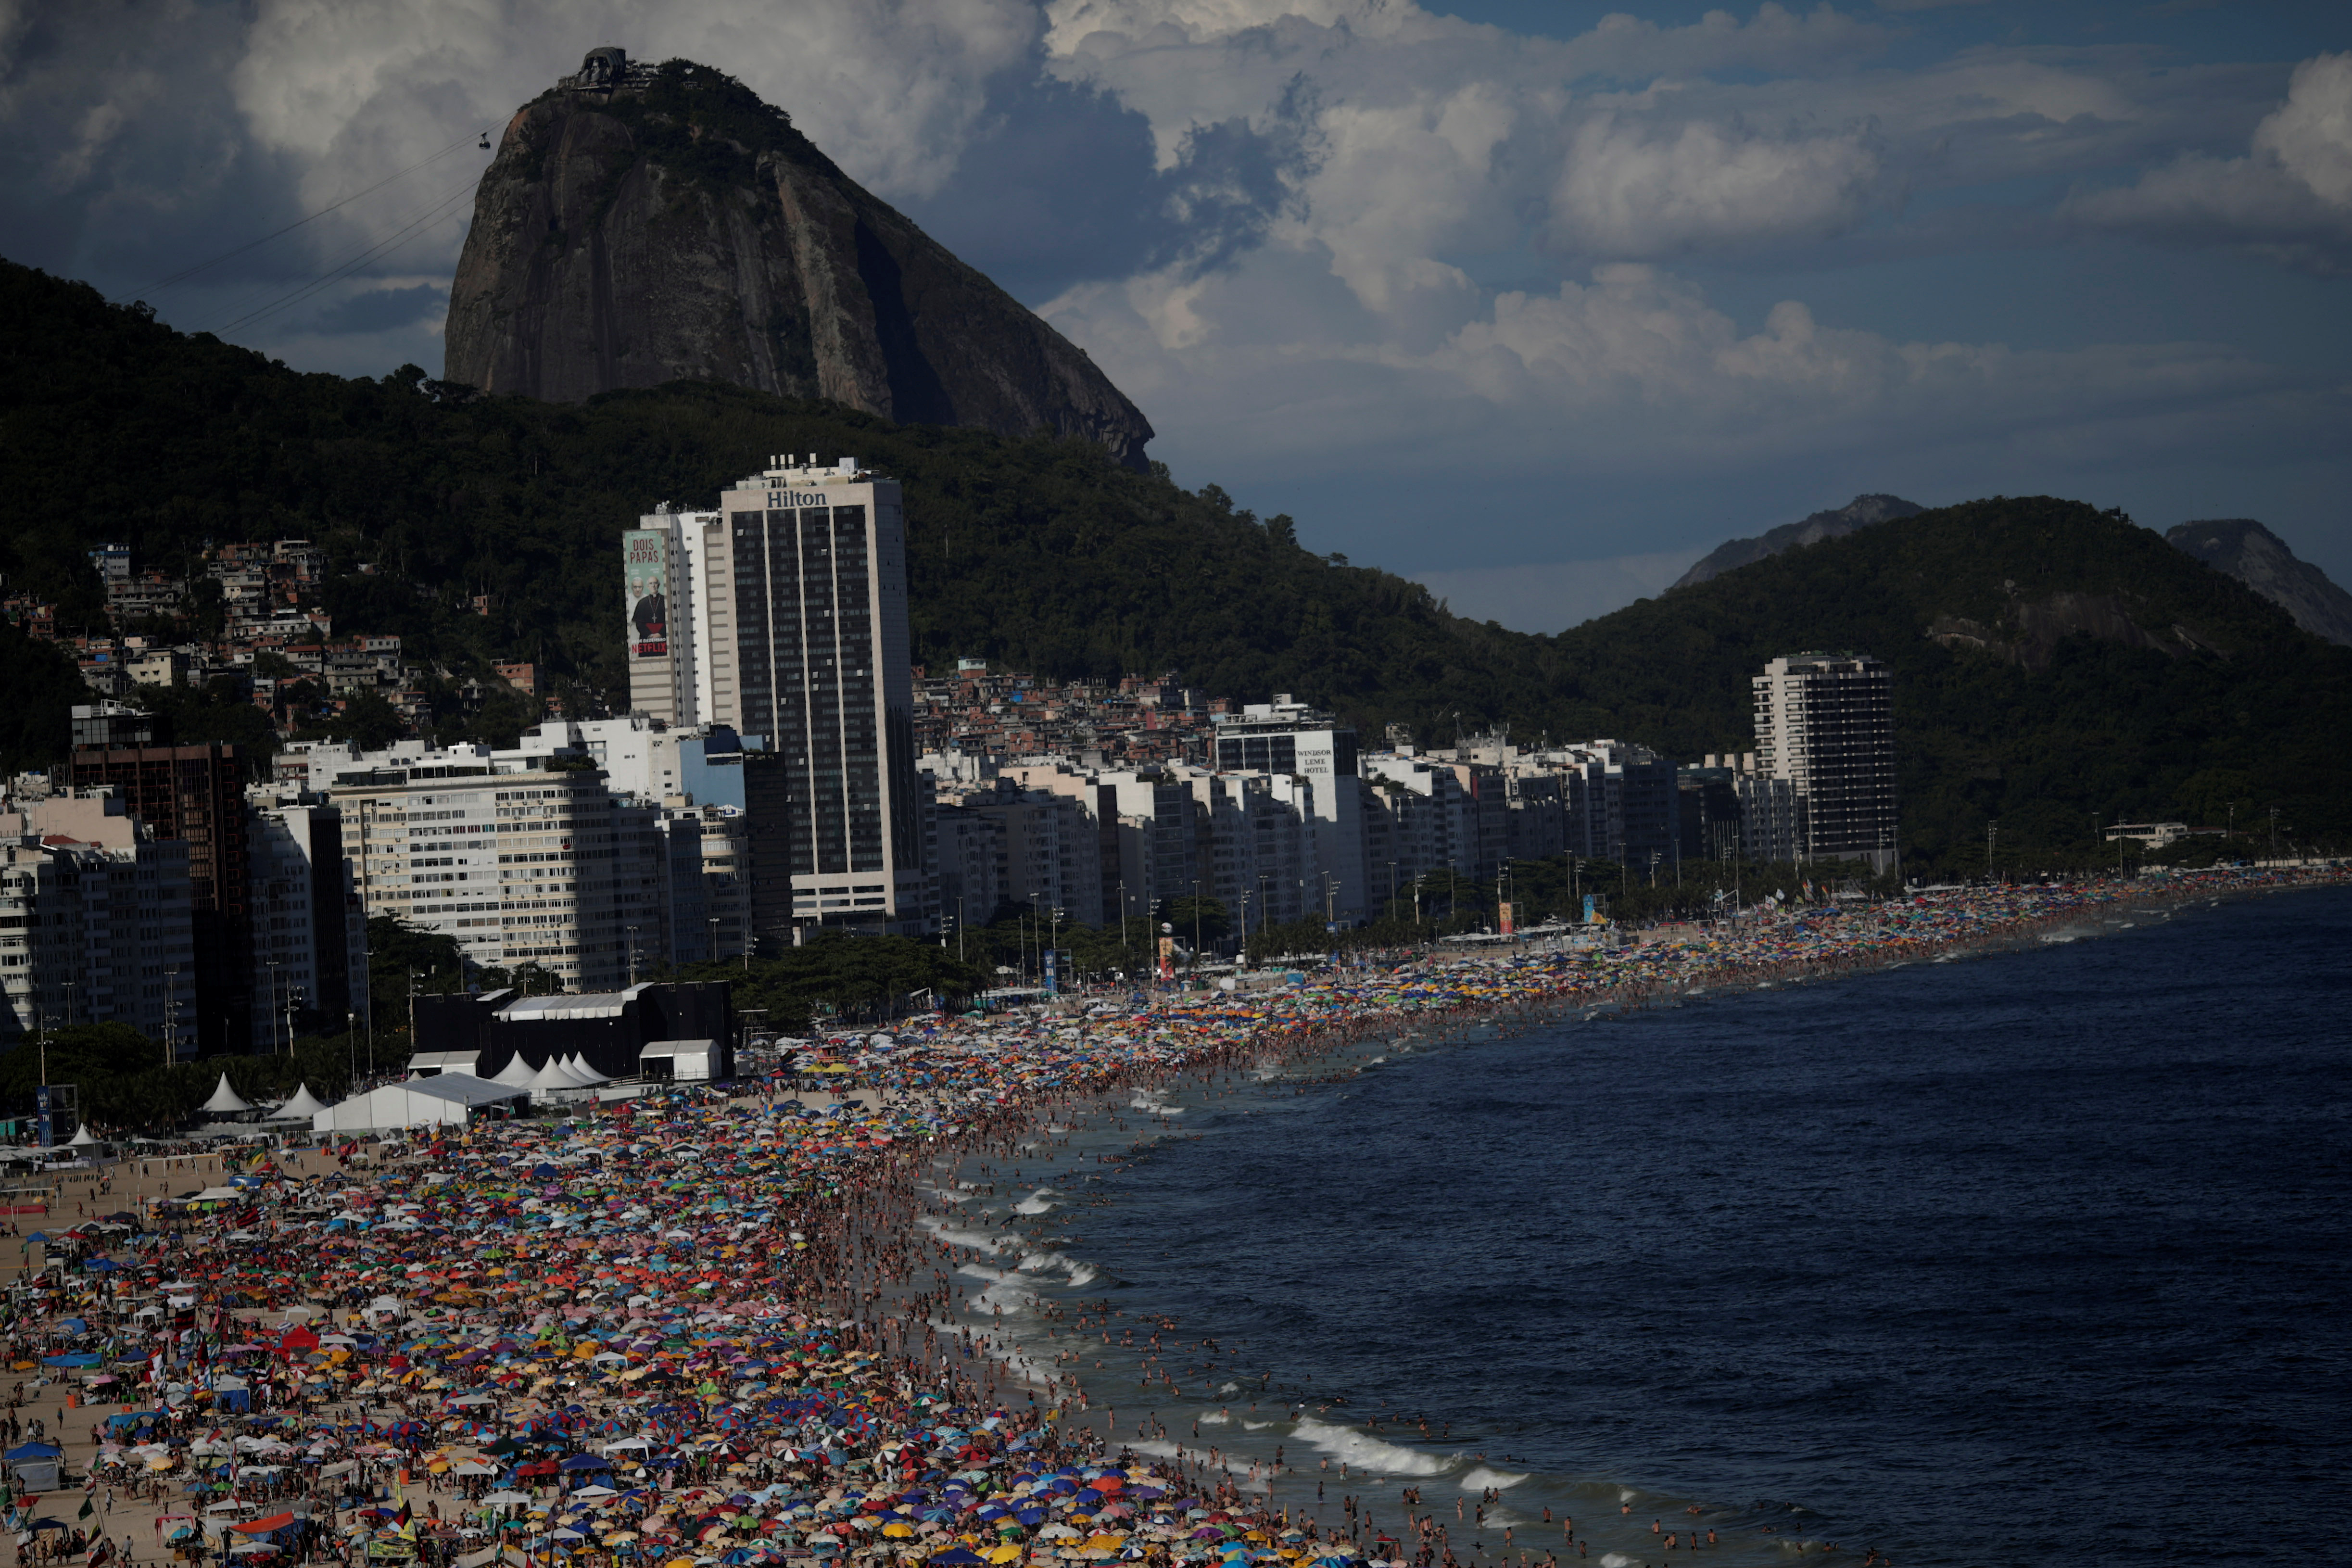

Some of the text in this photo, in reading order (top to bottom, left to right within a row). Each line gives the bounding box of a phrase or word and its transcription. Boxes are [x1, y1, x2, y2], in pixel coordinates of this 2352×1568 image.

[767, 491, 827, 507] Hilton
[633, 539, 654, 551] DOIS
[630, 551, 658, 564] PAPAS
[632, 642, 667, 654] NETFLIX
